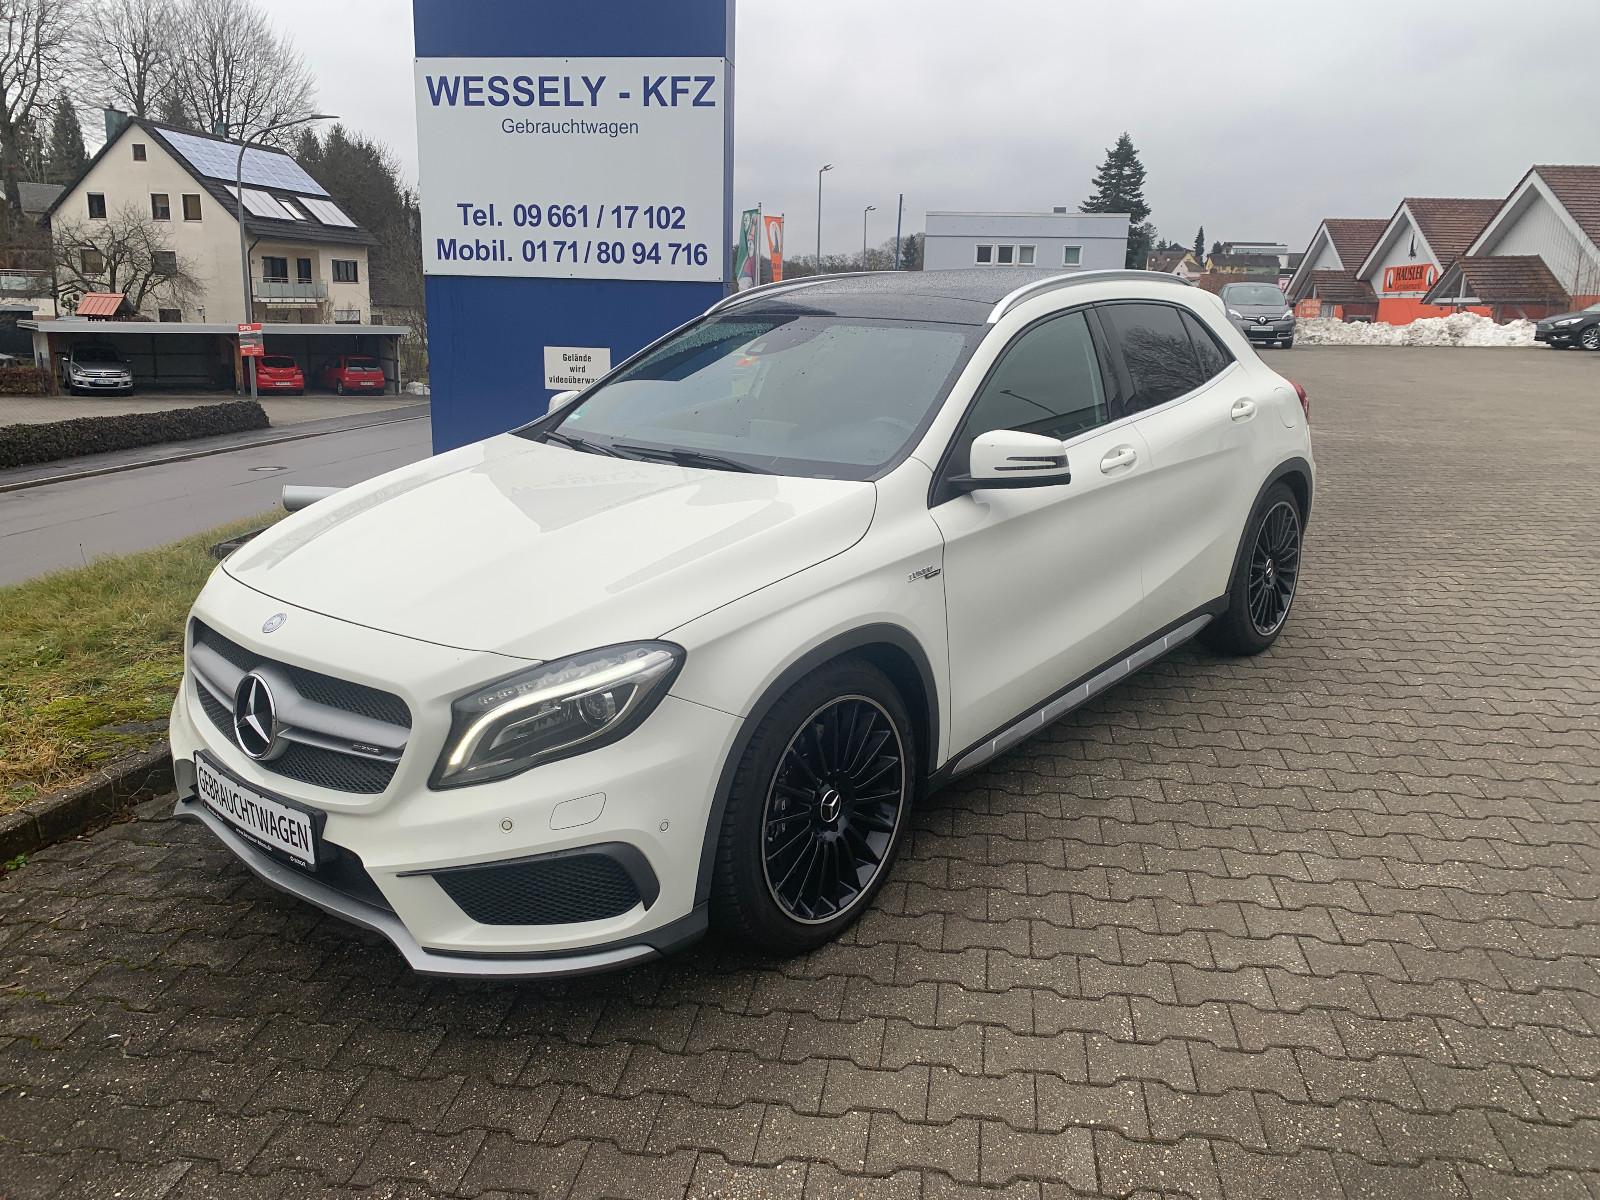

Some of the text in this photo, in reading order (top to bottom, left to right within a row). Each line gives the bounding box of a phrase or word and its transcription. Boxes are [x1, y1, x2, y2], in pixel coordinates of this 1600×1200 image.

[425, 75, 606, 107] WESSELY
[643, 75, 716, 107] KFZ
[501, 118, 639, 138] Gebrauchtwagen
[456, 203, 503, 227] Tel.
[436, 238, 513, 262] Mobil.
[562, 353, 592, 362] Gelände
[569, 365, 586, 373] wird
[198, 766, 310, 853] GEBRAUCHTWAGEN
